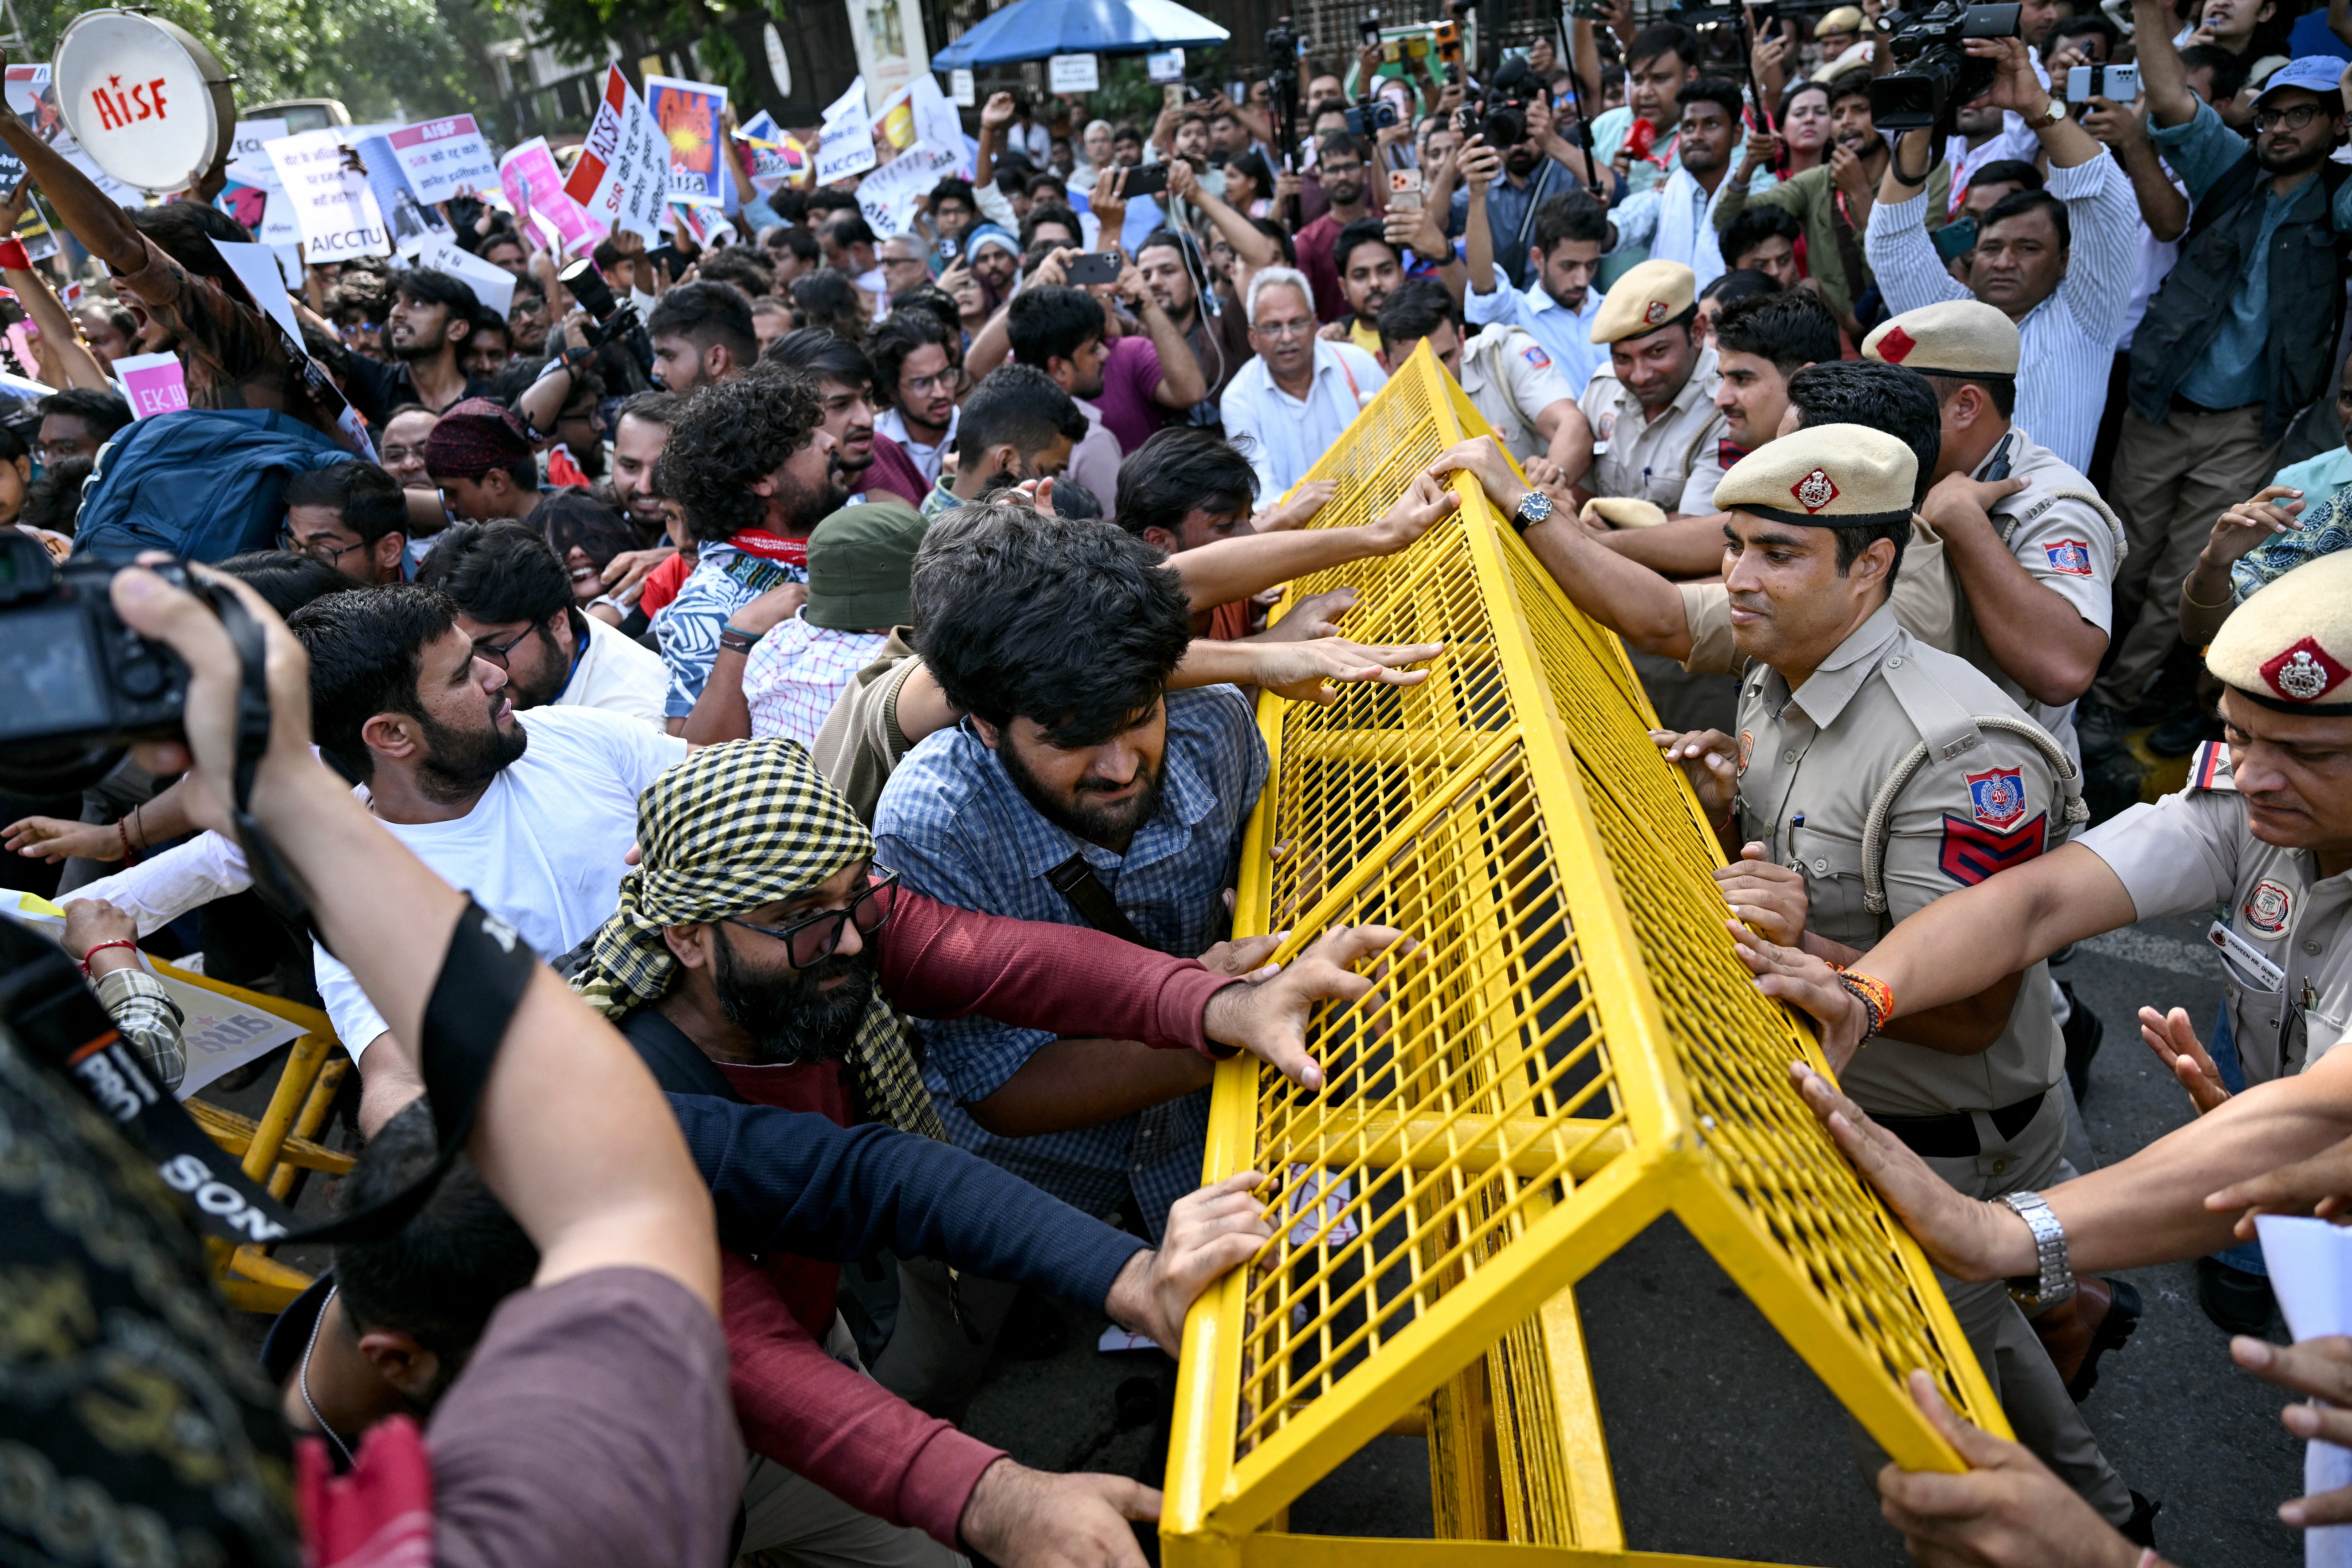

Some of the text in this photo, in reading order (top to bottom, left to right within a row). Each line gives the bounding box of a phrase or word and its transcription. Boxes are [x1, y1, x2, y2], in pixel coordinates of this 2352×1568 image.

[422, 121, 456, 140] AISF
[592, 105, 620, 166] AISF
[607, 182, 624, 213] SIR
[312, 227, 382, 252] AICCTU
[140, 388, 171, 412] EK
[1988, 798, 1996, 808] DELHI
[2228, 939, 2279, 981] PRAVEEN KR. DUBEY
[2261, 975, 2274, 987] A.S.I.
[159, 1153, 289, 1242] SON
